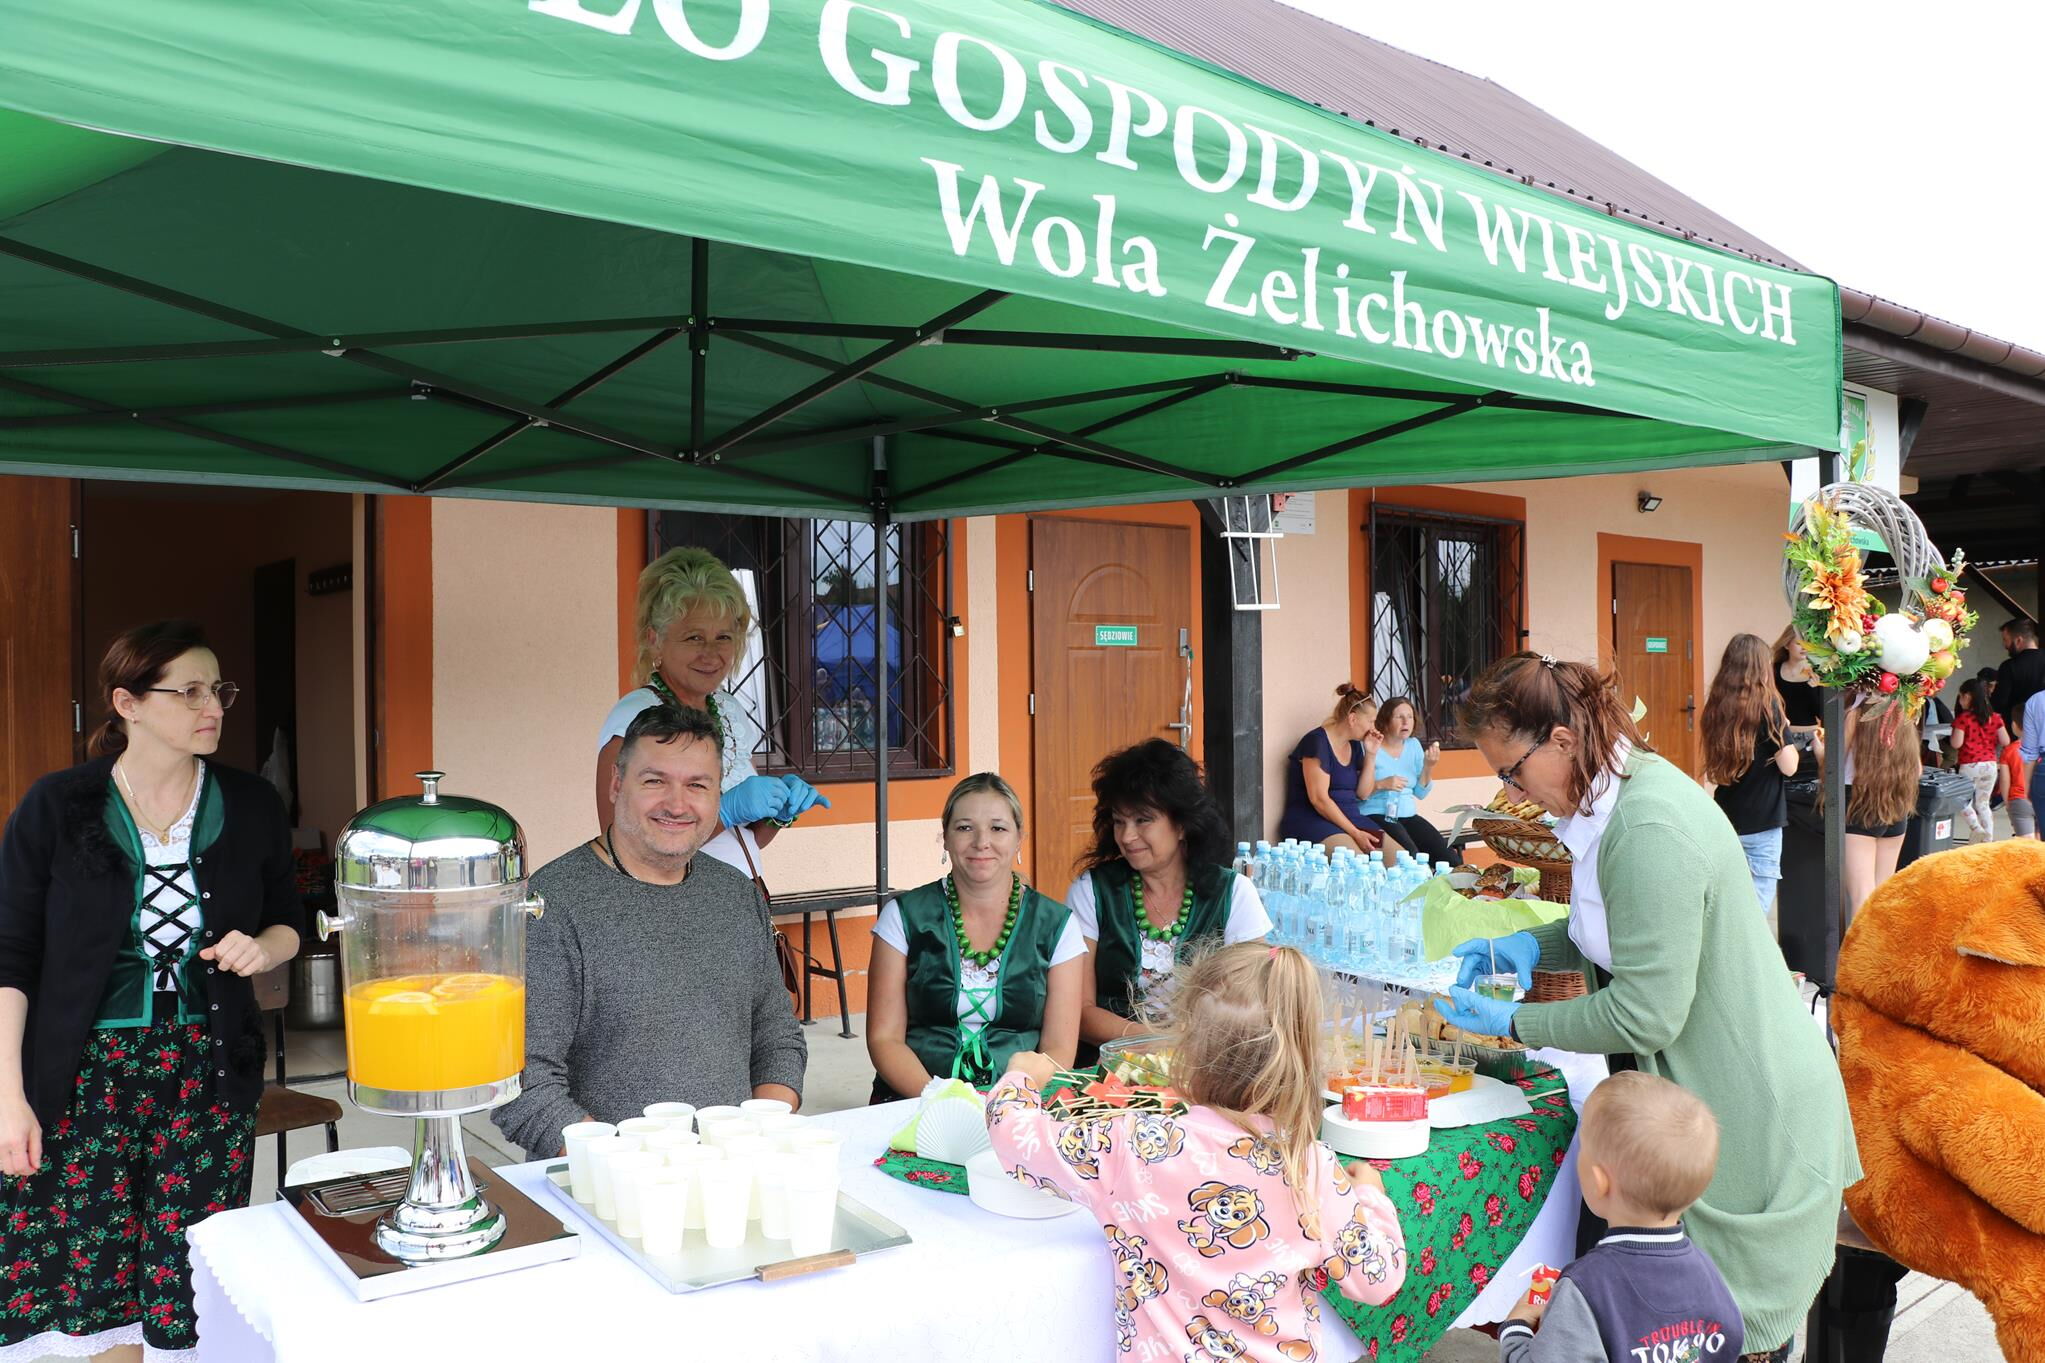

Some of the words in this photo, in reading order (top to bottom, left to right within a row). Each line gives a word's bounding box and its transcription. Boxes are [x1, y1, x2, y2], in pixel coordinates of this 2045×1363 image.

[818, 0, 1448, 253] GOSPODYŃ
[1456, 190, 1797, 346] WIEJSKICH
[920, 156, 1168, 297] Wola
[1201, 213, 1596, 387] Żelichowska
[1638, 1318, 1705, 1347] TROUBLE
